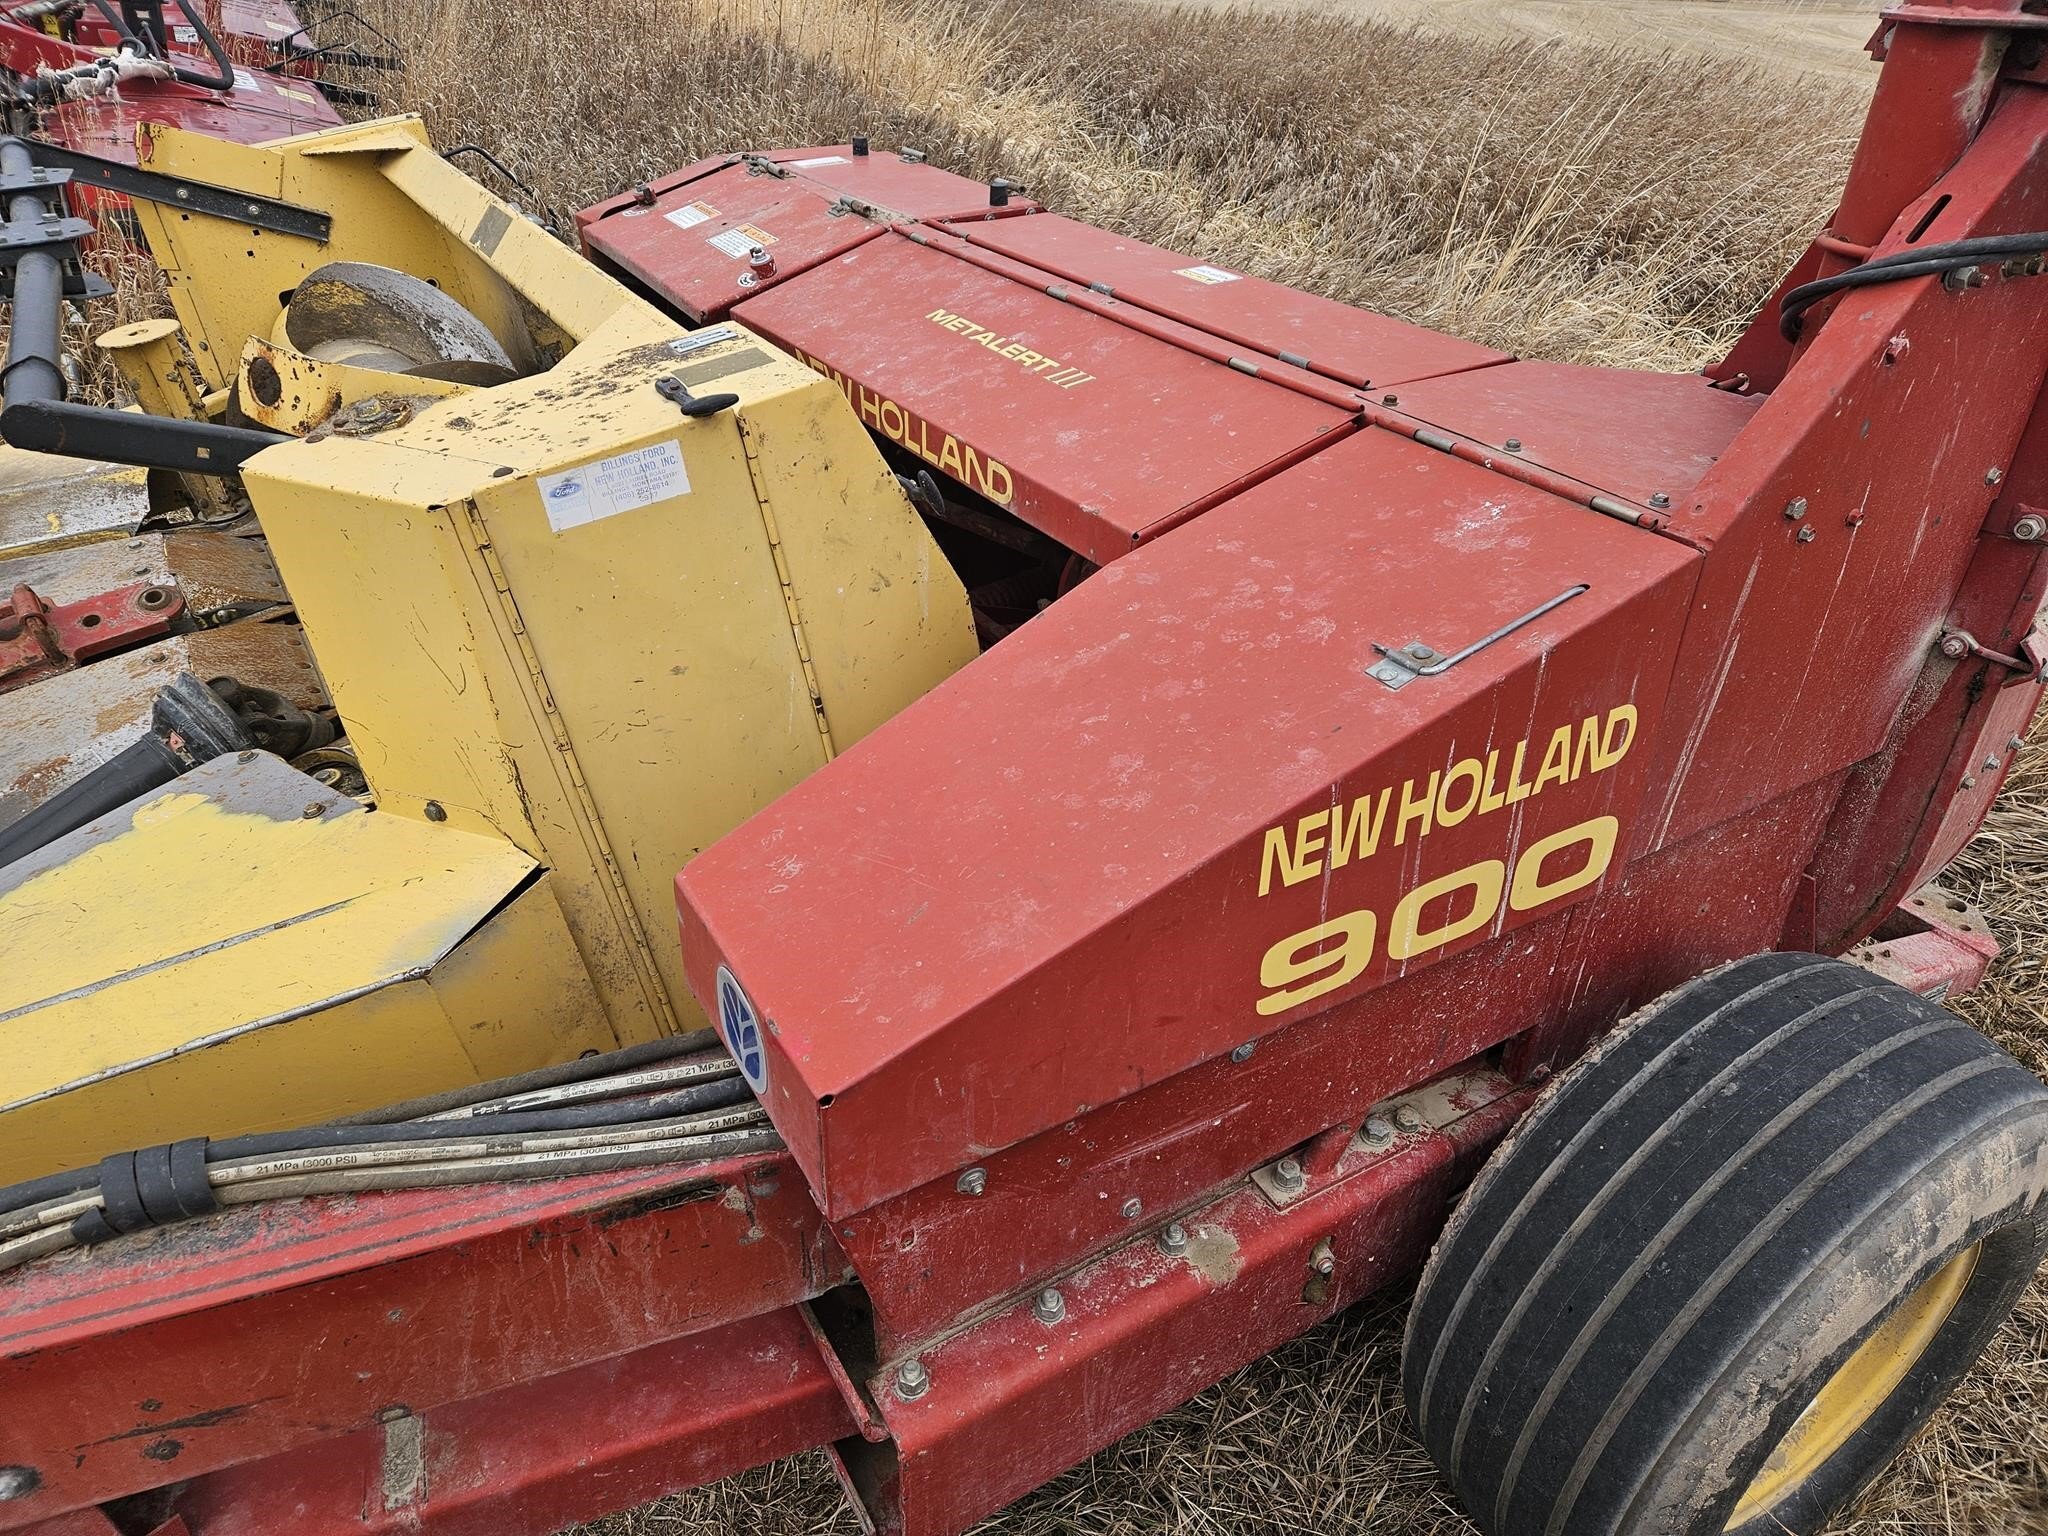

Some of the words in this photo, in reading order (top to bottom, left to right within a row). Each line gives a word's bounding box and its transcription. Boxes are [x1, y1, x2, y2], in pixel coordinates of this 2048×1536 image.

[925, 309, 1060, 372] METALERT
[1043, 367, 1096, 389] III
[859, 384, 1014, 505] HOLLAND
[594, 471, 614, 487] NEW
[661, 455, 679, 468] INC.
[601, 453, 640, 472] BILLINGS
[642, 446, 666, 460] FORD
[554, 485, 577, 497] Ford
[1258, 786, 1393, 898] NEW
[1394, 703, 1638, 847] HOLLAND
[1255, 815, 1619, 1016] 900
[685, 1068, 696, 1076] 21
[699, 1062, 721, 1073] MPa
[708, 1120, 720, 1130] 21
[723, 1116, 745, 1127] MPa
[256, 1165, 269, 1174] 21
[273, 1161, 299, 1173] MPa
[302, 1156, 332, 1168] (3000
[335, 1154, 357, 1165] PSI)
[538, 1152, 550, 1160] 21
